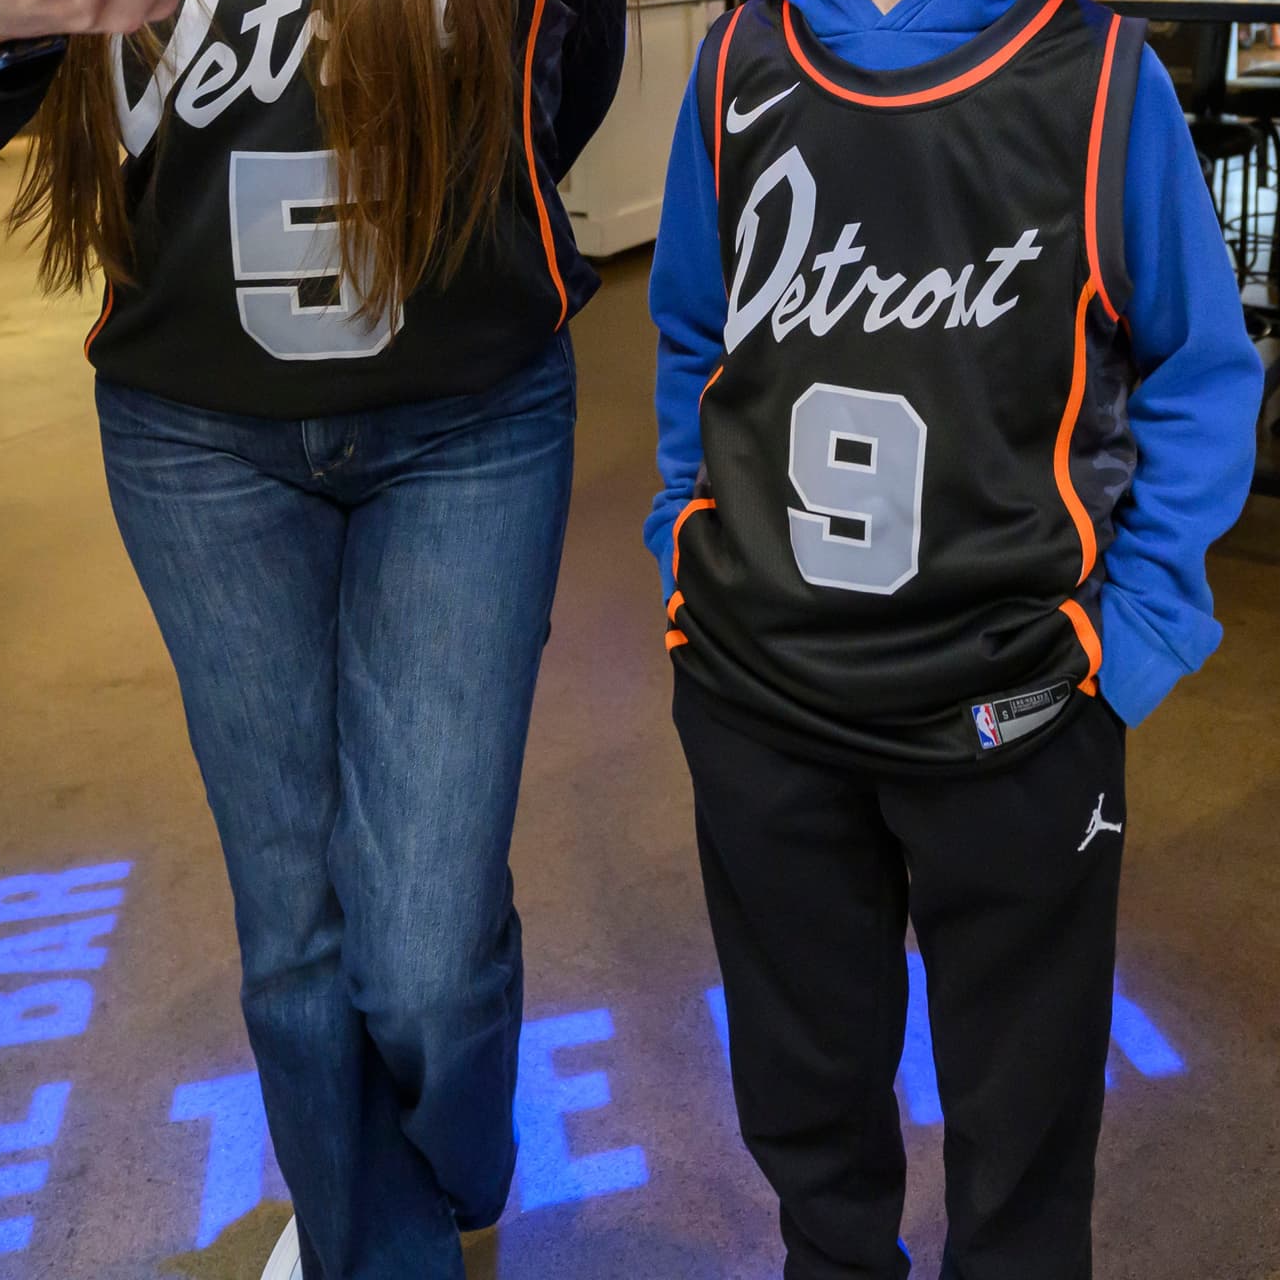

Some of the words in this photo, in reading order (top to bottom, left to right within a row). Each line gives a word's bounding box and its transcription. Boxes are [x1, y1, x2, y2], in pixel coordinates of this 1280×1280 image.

[723, 145, 1043, 355] Detroit
[787, 381, 928, 596] 9
[169, 1008, 647, 1250] TE
